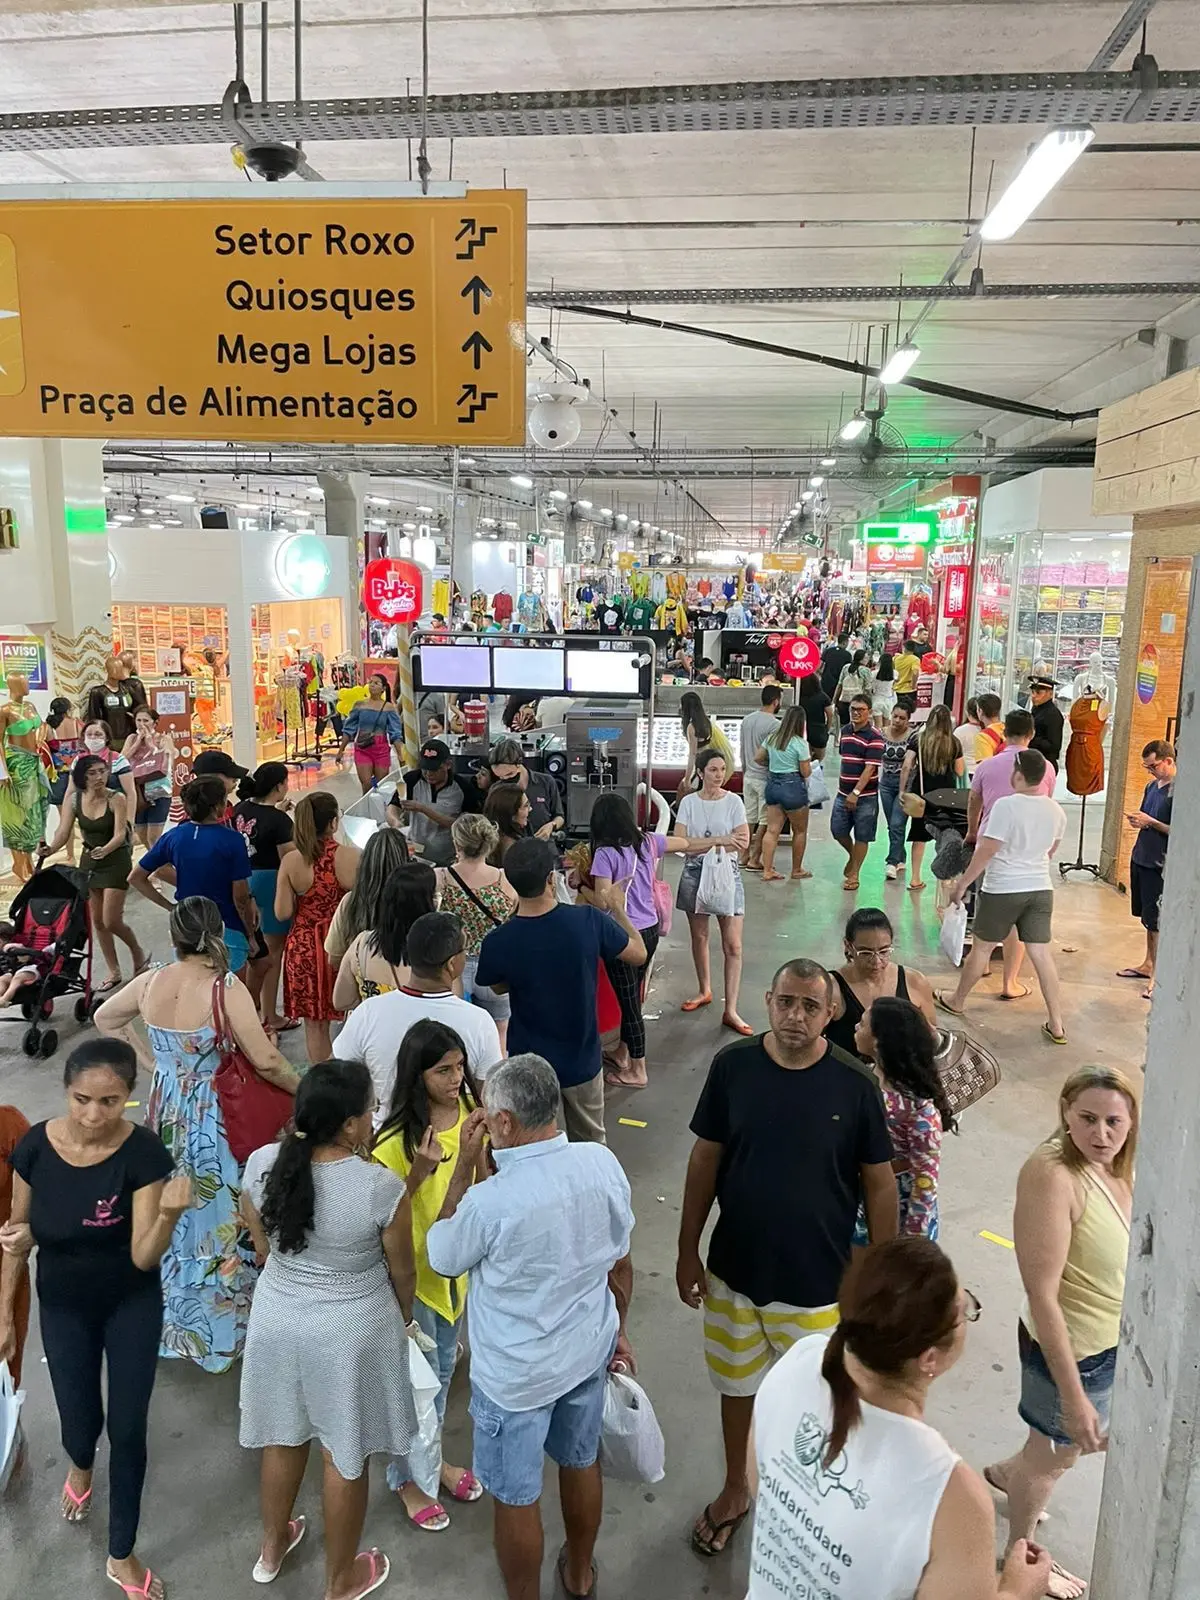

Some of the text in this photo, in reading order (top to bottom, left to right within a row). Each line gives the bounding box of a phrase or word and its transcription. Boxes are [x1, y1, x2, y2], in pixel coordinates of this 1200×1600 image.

[214, 223, 415, 256] Setor Roxo
[225, 279, 416, 320] Quiosques
[217, 334, 417, 375] Mega Lojas
[40, 384, 418, 427] Praça de Alimentação
[371, 578, 416, 600] Bob's
[4, 645, 37, 656] AVISO
[820, 1561, 841, 1585] de
